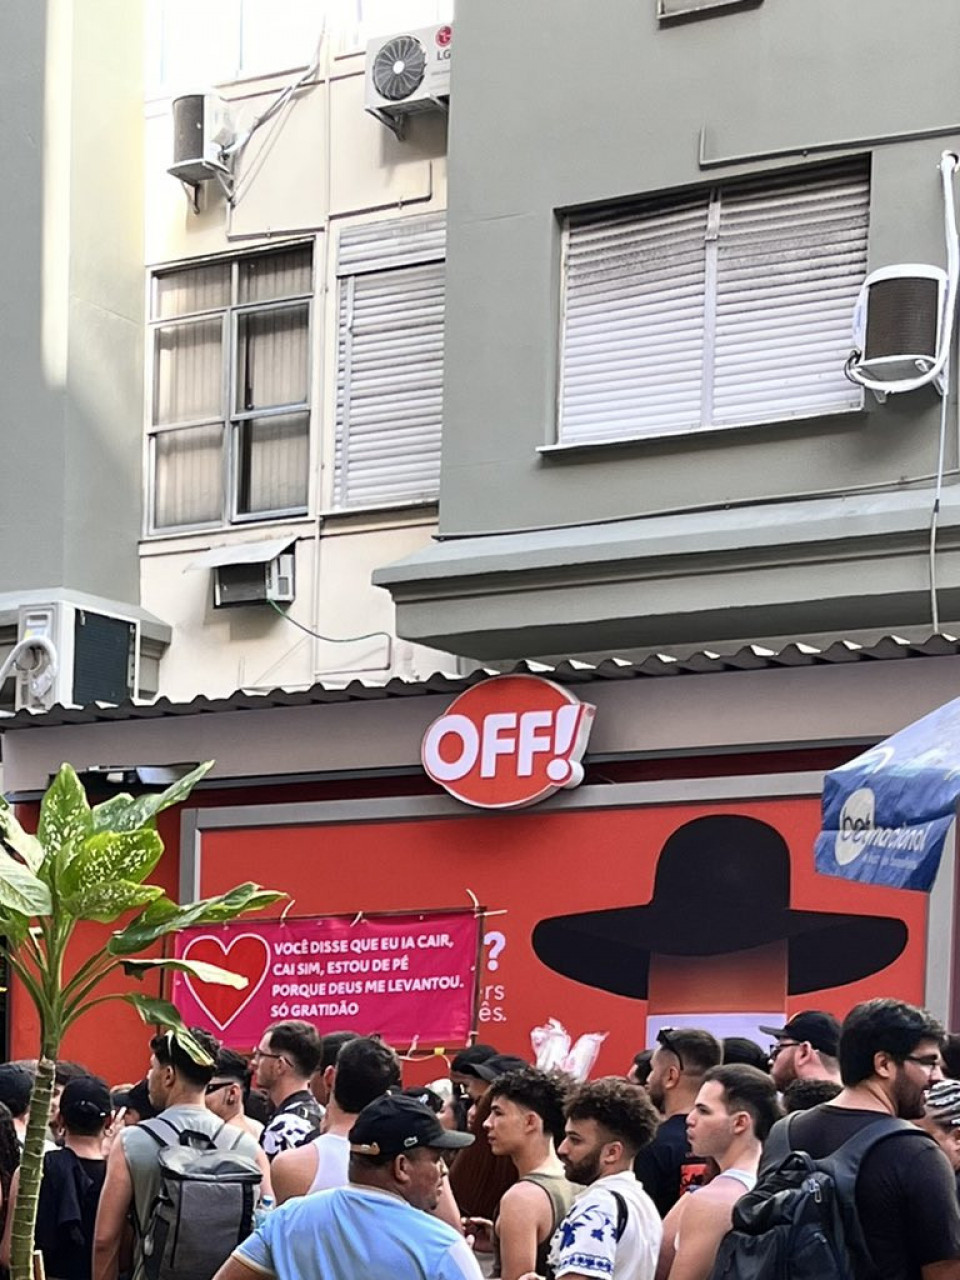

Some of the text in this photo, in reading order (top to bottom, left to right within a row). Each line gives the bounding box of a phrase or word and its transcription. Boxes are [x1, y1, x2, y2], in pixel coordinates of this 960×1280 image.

[436, 49, 451, 61] LG
[423, 704, 581, 781] OFF!
[274, 934, 454, 955] VOCÊ DISSE QUE EU IA CAIR,
[272, 955, 409, 976] CAI SIM, ESTOU DE PÉ
[272, 975, 464, 998] PORQUE DEUS ME LEVANTOU.
[271, 1001, 359, 1018] SÓ GRATIDÃO
